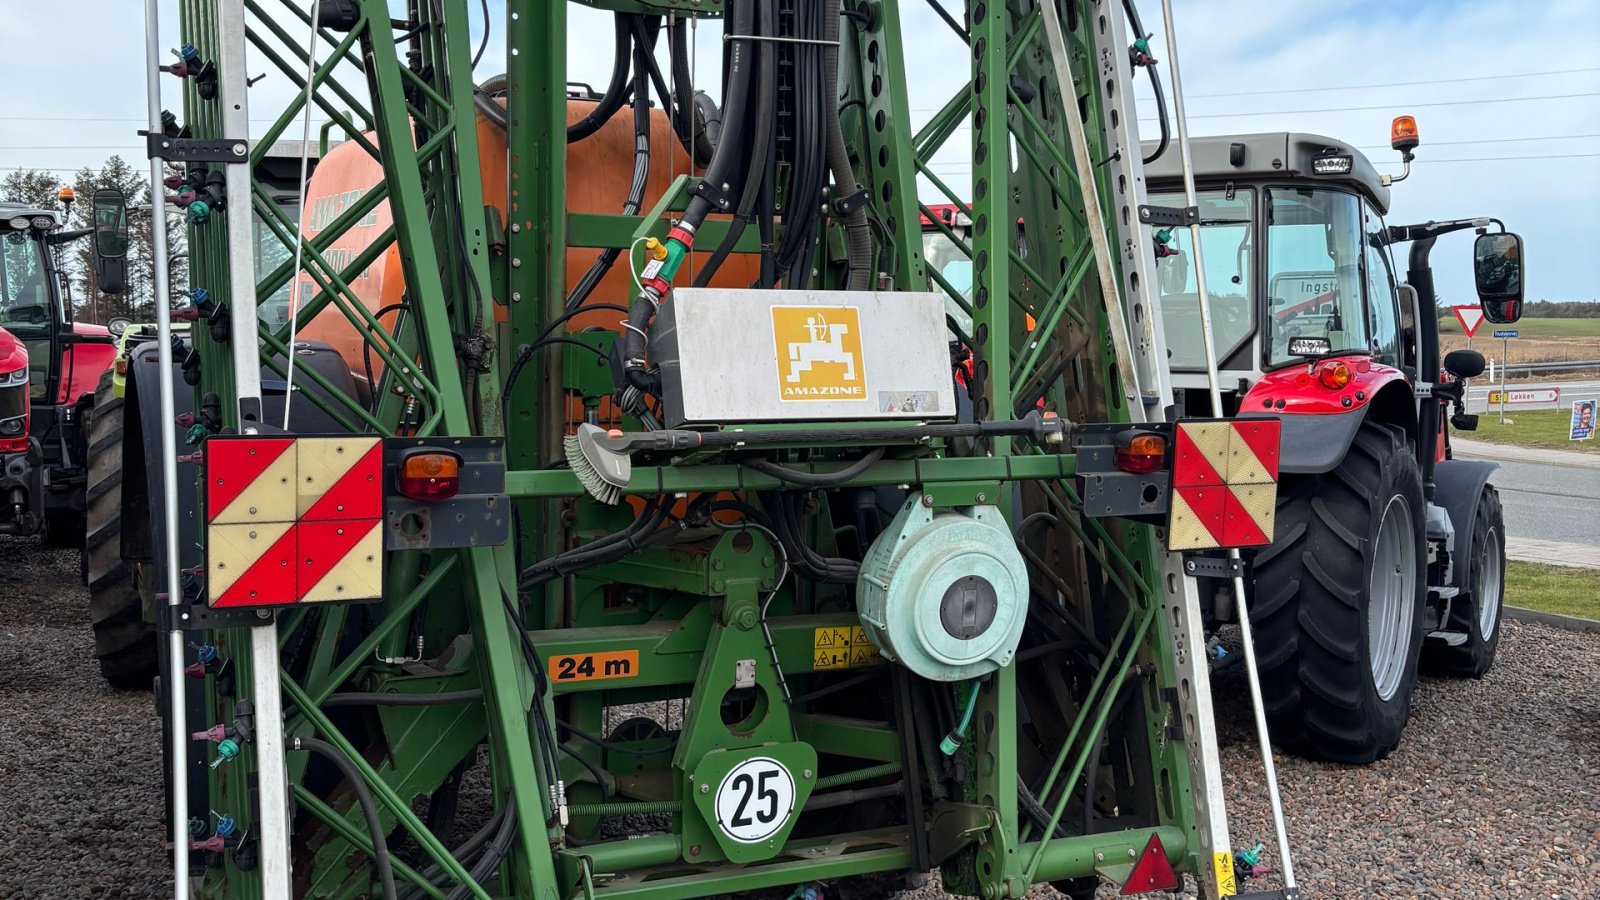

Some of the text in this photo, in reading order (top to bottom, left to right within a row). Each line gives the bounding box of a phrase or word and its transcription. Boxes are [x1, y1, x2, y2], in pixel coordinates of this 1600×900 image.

[784, 387, 861, 395] AMAZONE
[558, 656, 630, 679] 24 m
[731, 769, 779, 828] 25
